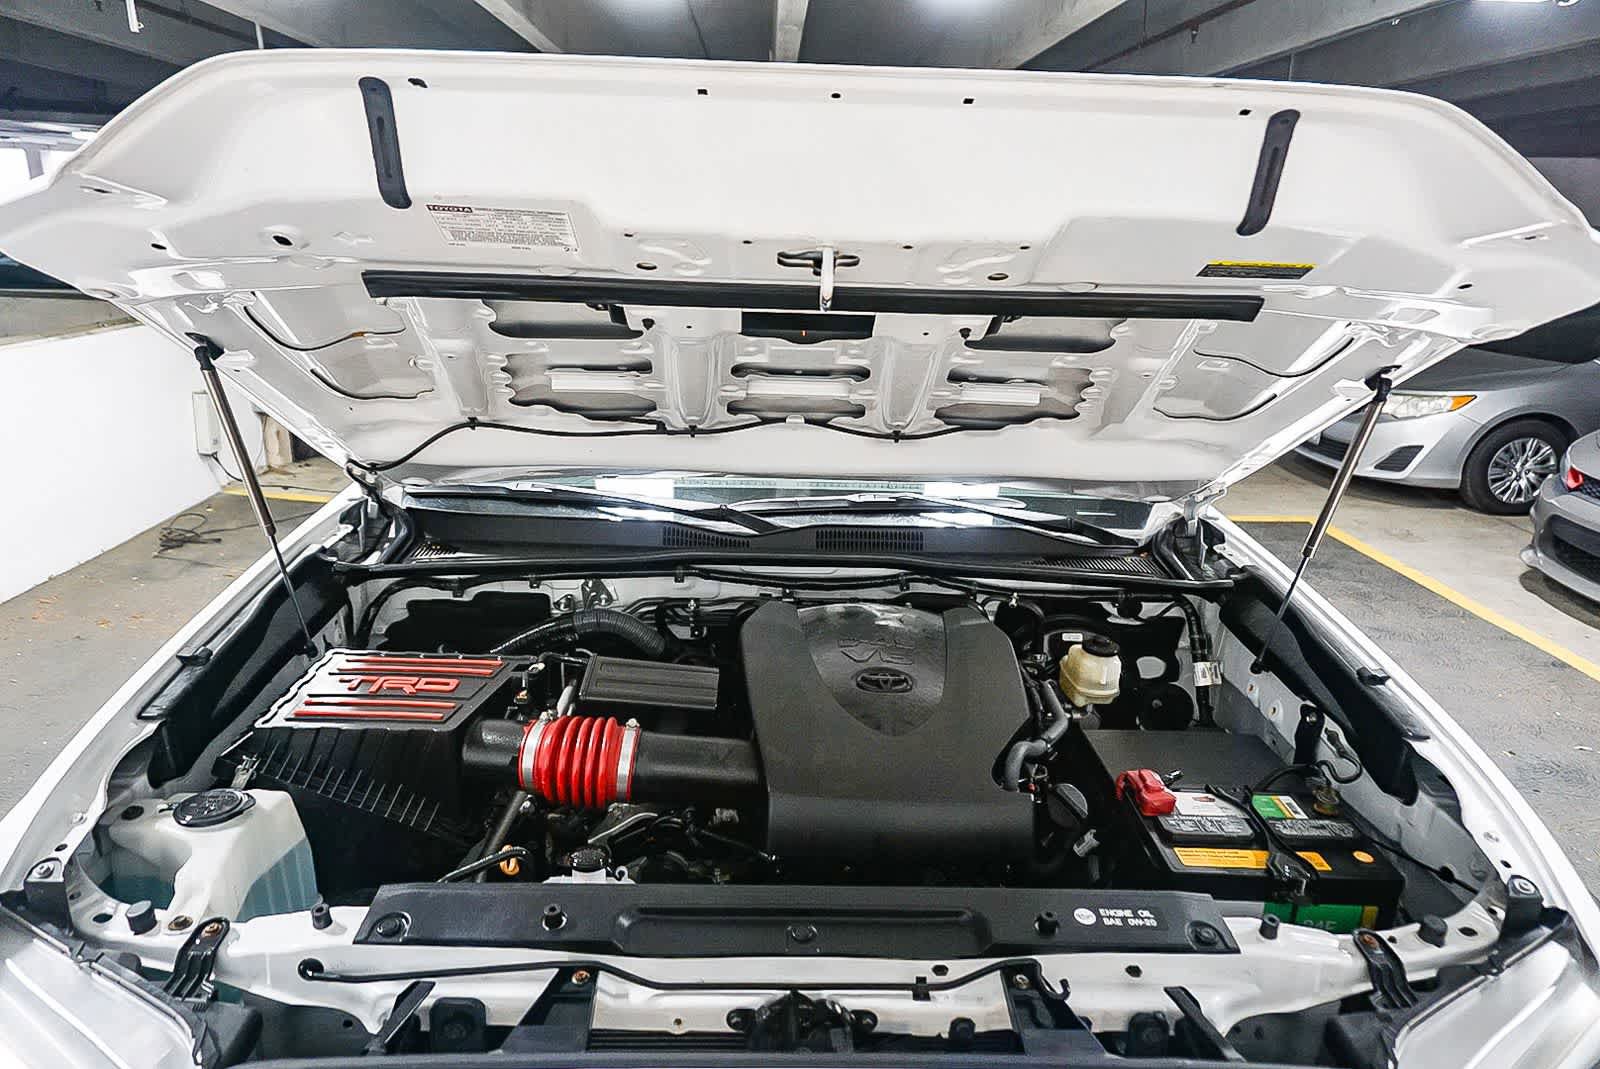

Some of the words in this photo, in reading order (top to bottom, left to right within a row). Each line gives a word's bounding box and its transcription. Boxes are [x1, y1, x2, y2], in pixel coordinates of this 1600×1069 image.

[427, 205, 472, 213] TOYOTA
[339, 676, 461, 696] TRD
[1098, 908, 1134, 917] ENGINE
[1137, 909, 1155, 918] OIL
[1102, 918, 1124, 926] SAE
